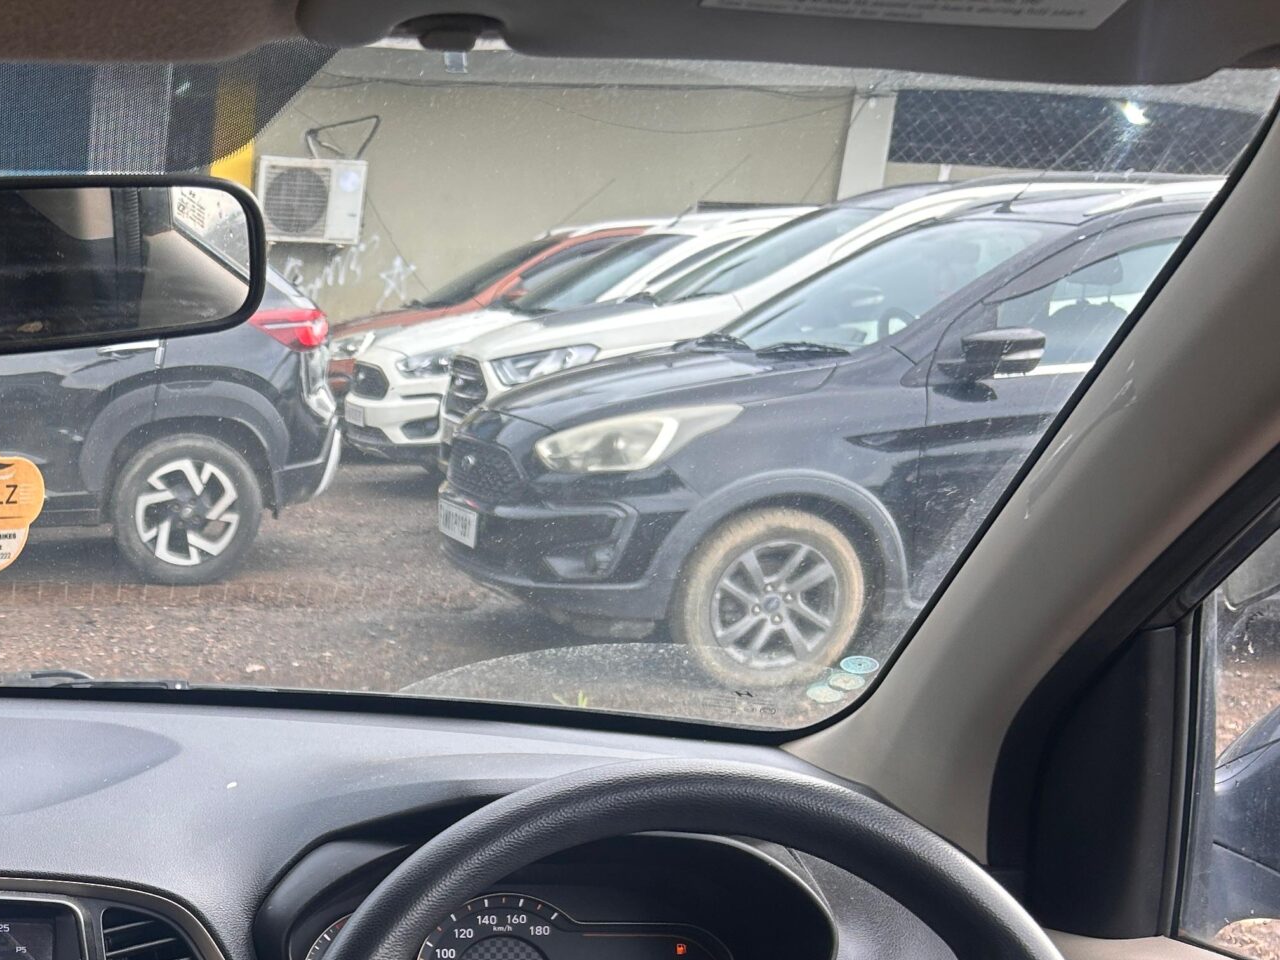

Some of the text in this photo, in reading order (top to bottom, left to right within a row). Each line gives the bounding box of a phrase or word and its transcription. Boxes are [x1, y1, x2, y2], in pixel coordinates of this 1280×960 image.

[477, 915, 497, 925] 140
[506, 915, 527, 924] 160
[454, 928, 473, 938] 120
[530, 926, 550, 936] 180
[436, 949, 456, 958] 100
